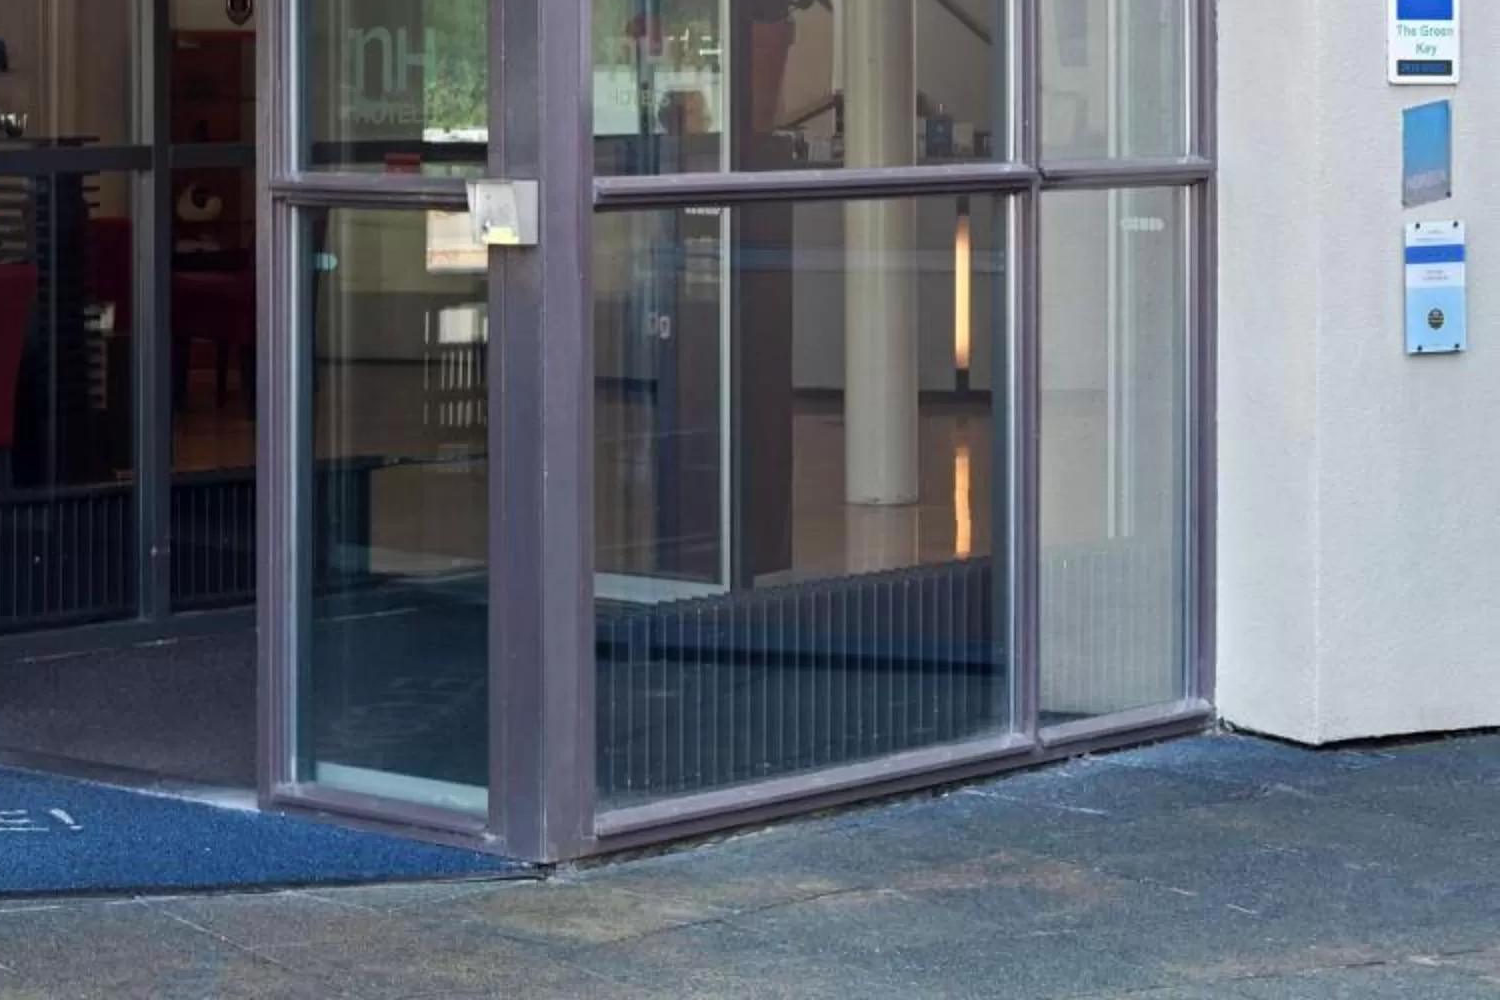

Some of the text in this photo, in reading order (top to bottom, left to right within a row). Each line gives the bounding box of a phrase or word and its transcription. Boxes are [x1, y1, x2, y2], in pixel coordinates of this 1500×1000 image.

[1396, 24, 1454, 37] The Green
[1415, 42, 1437, 56] Key
